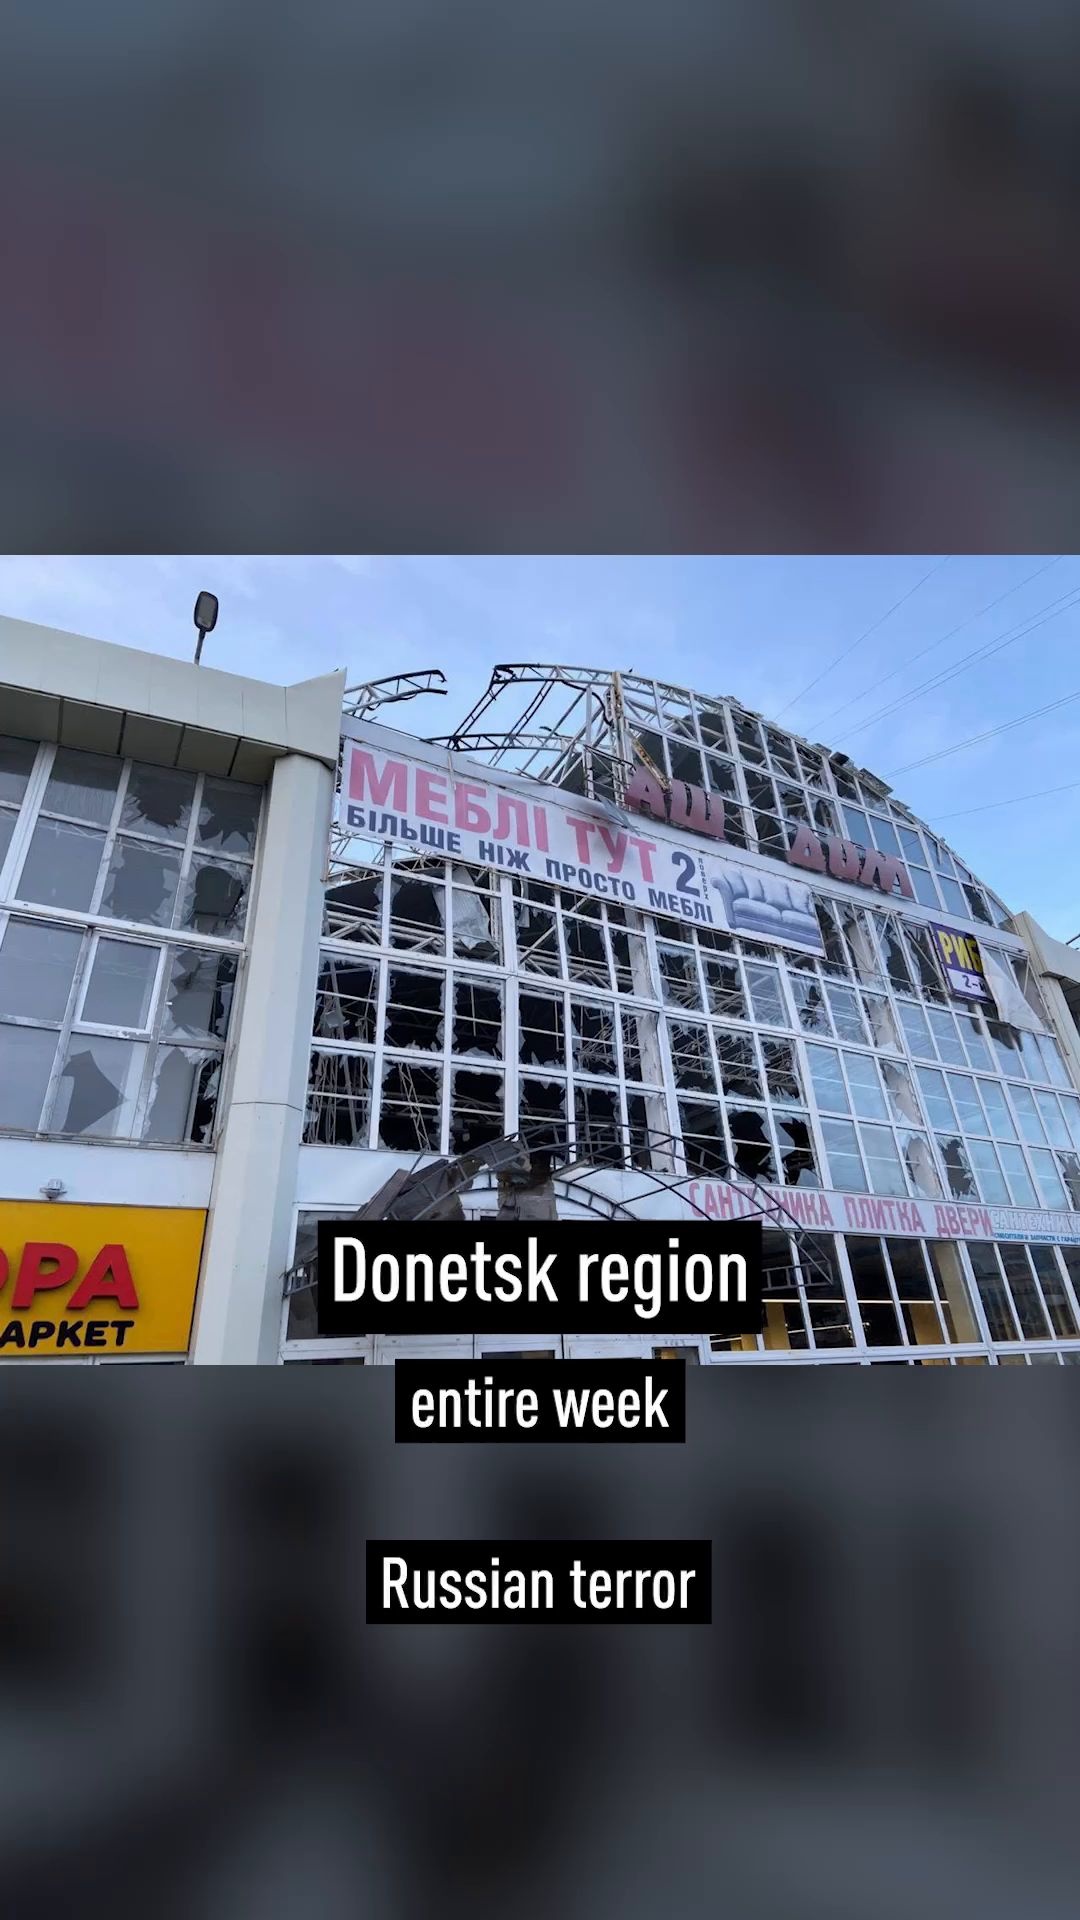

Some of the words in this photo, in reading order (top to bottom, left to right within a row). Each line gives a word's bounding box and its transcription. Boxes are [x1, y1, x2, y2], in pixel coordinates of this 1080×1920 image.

[349, 748, 549, 853] МЕБЛІ
[566, 815, 657, 883] ТУТ
[347, 804, 462, 854] БІЛЬШЕ
[479, 840, 532, 872] НІЖ
[546, 858, 636, 901] ПРОСТО
[648, 888, 714, 923] МЕБЛІ
[671, 851, 701, 897] 2
[787, 823, 915, 898] ДОМ
[689, 1182, 834, 1227] САНТЕХНИКА
[843, 1195, 926, 1233] ПЛИТКА
[934, 1205, 993, 1238] ДВЕРИ
[0, 1242, 139, 1310] РА
